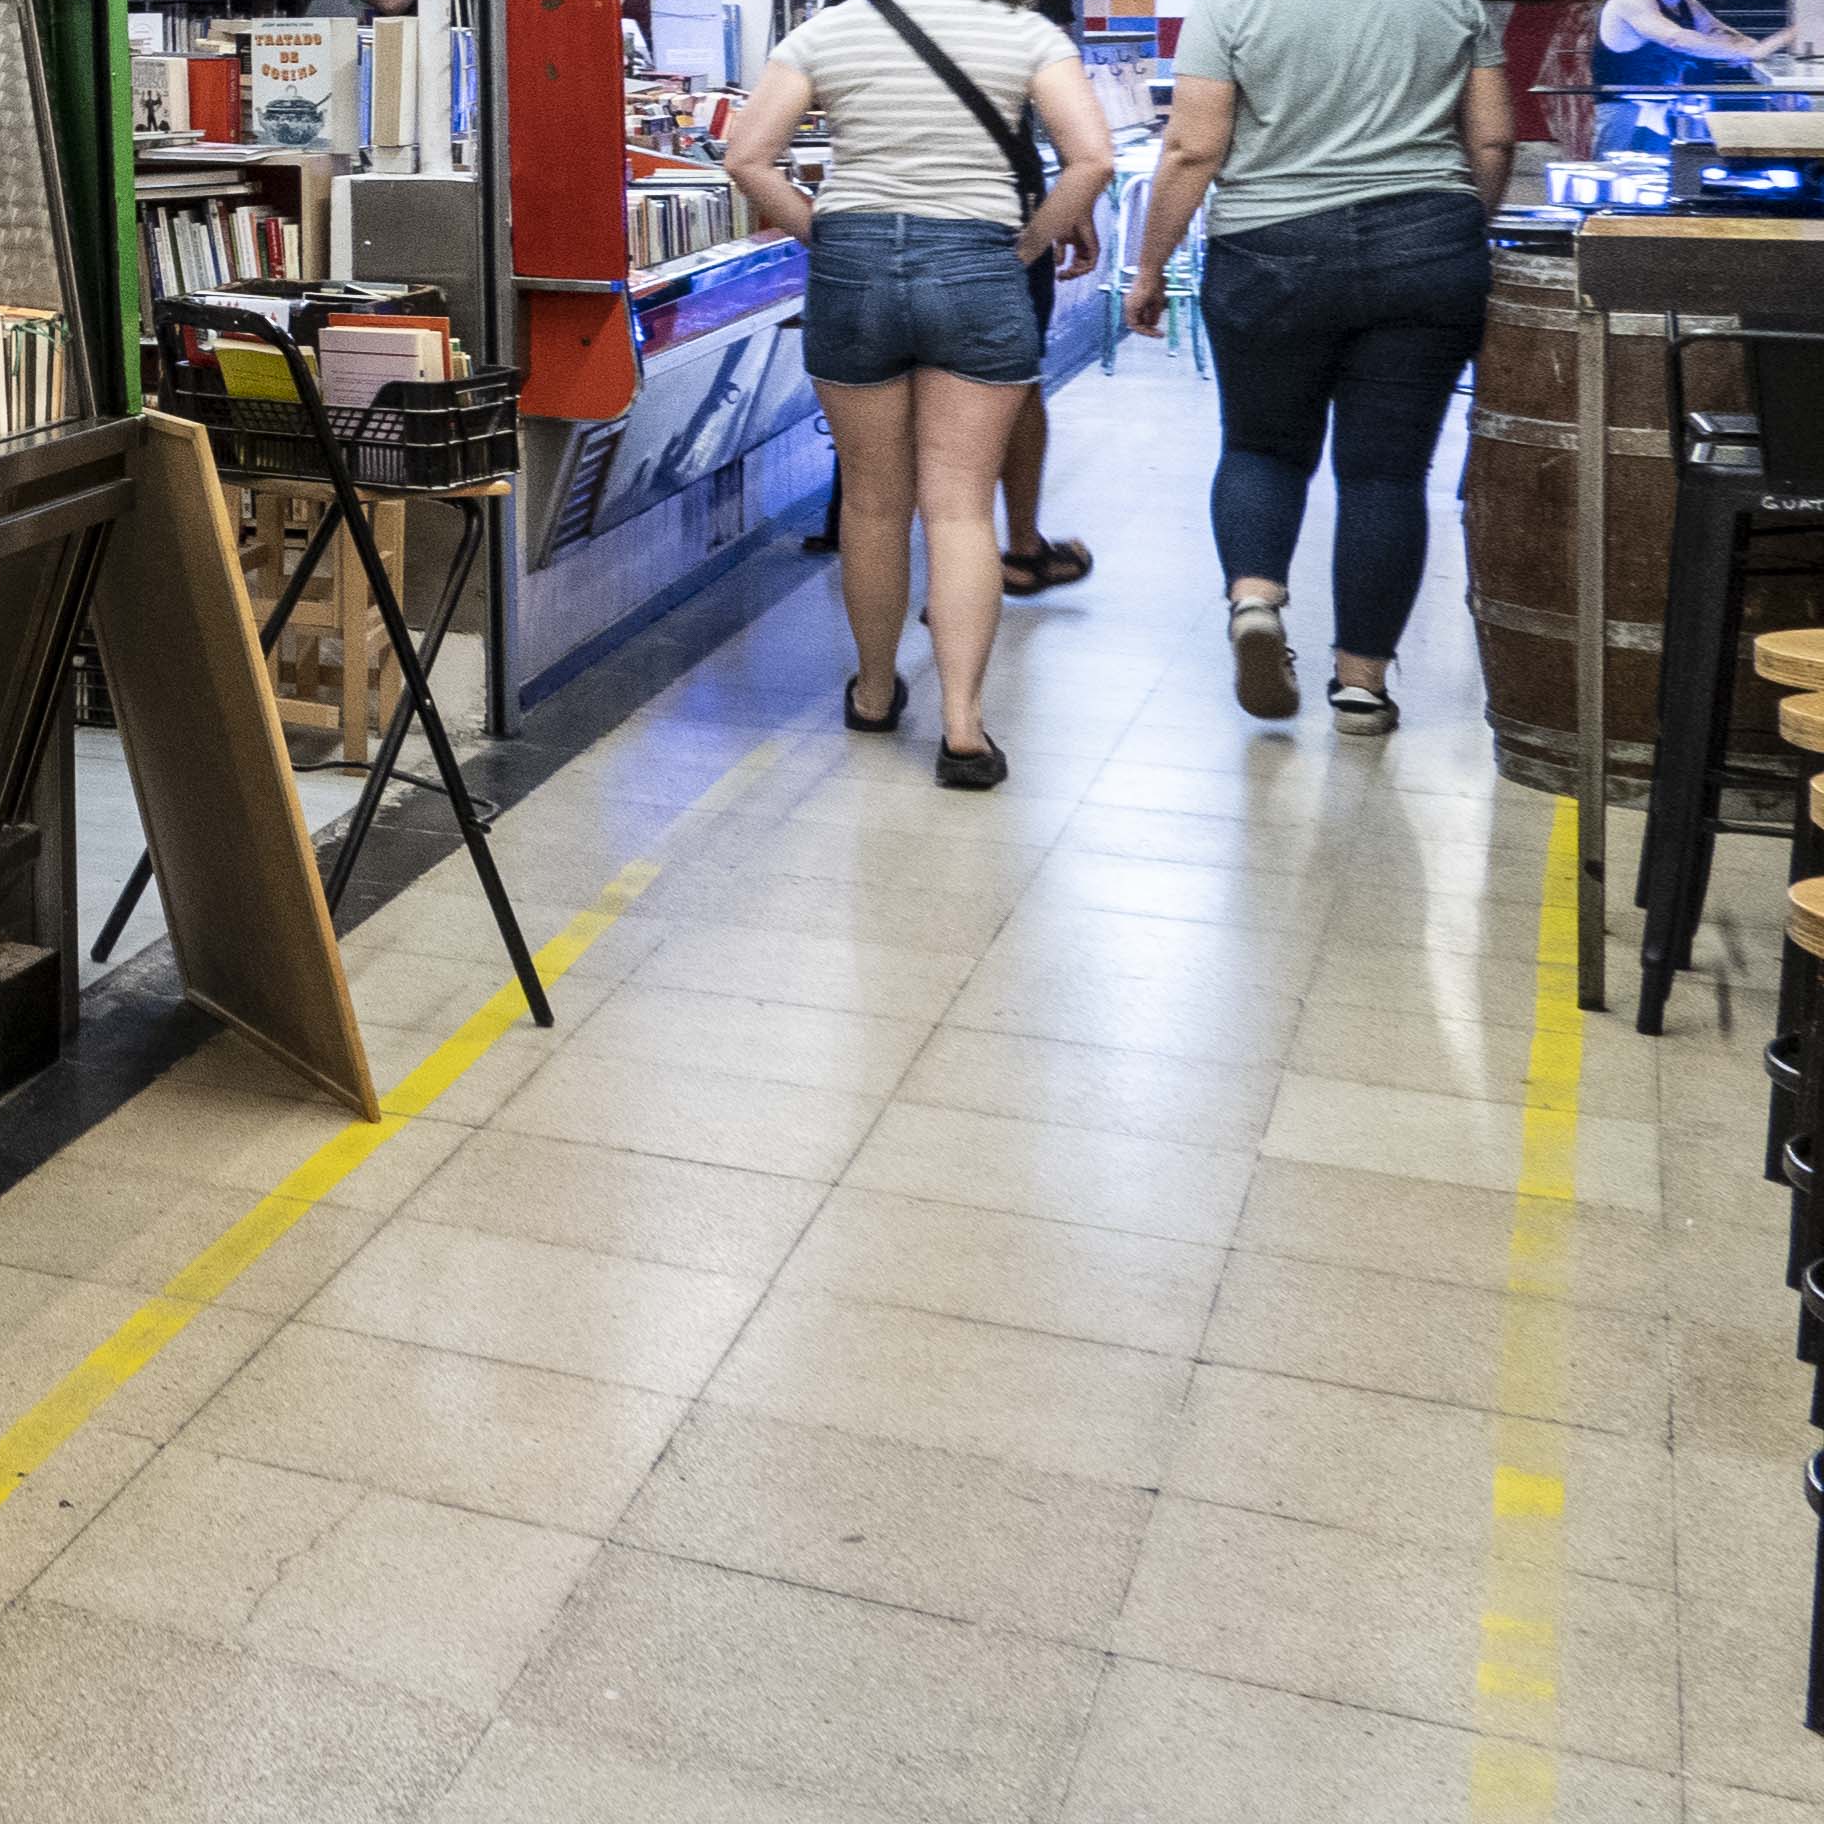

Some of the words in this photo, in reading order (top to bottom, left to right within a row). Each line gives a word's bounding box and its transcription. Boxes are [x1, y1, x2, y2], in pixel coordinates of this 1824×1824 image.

[255, 34, 322, 46] TRATADO
[280, 51, 300, 63] DE
[261, 63, 318, 81] COCINA
